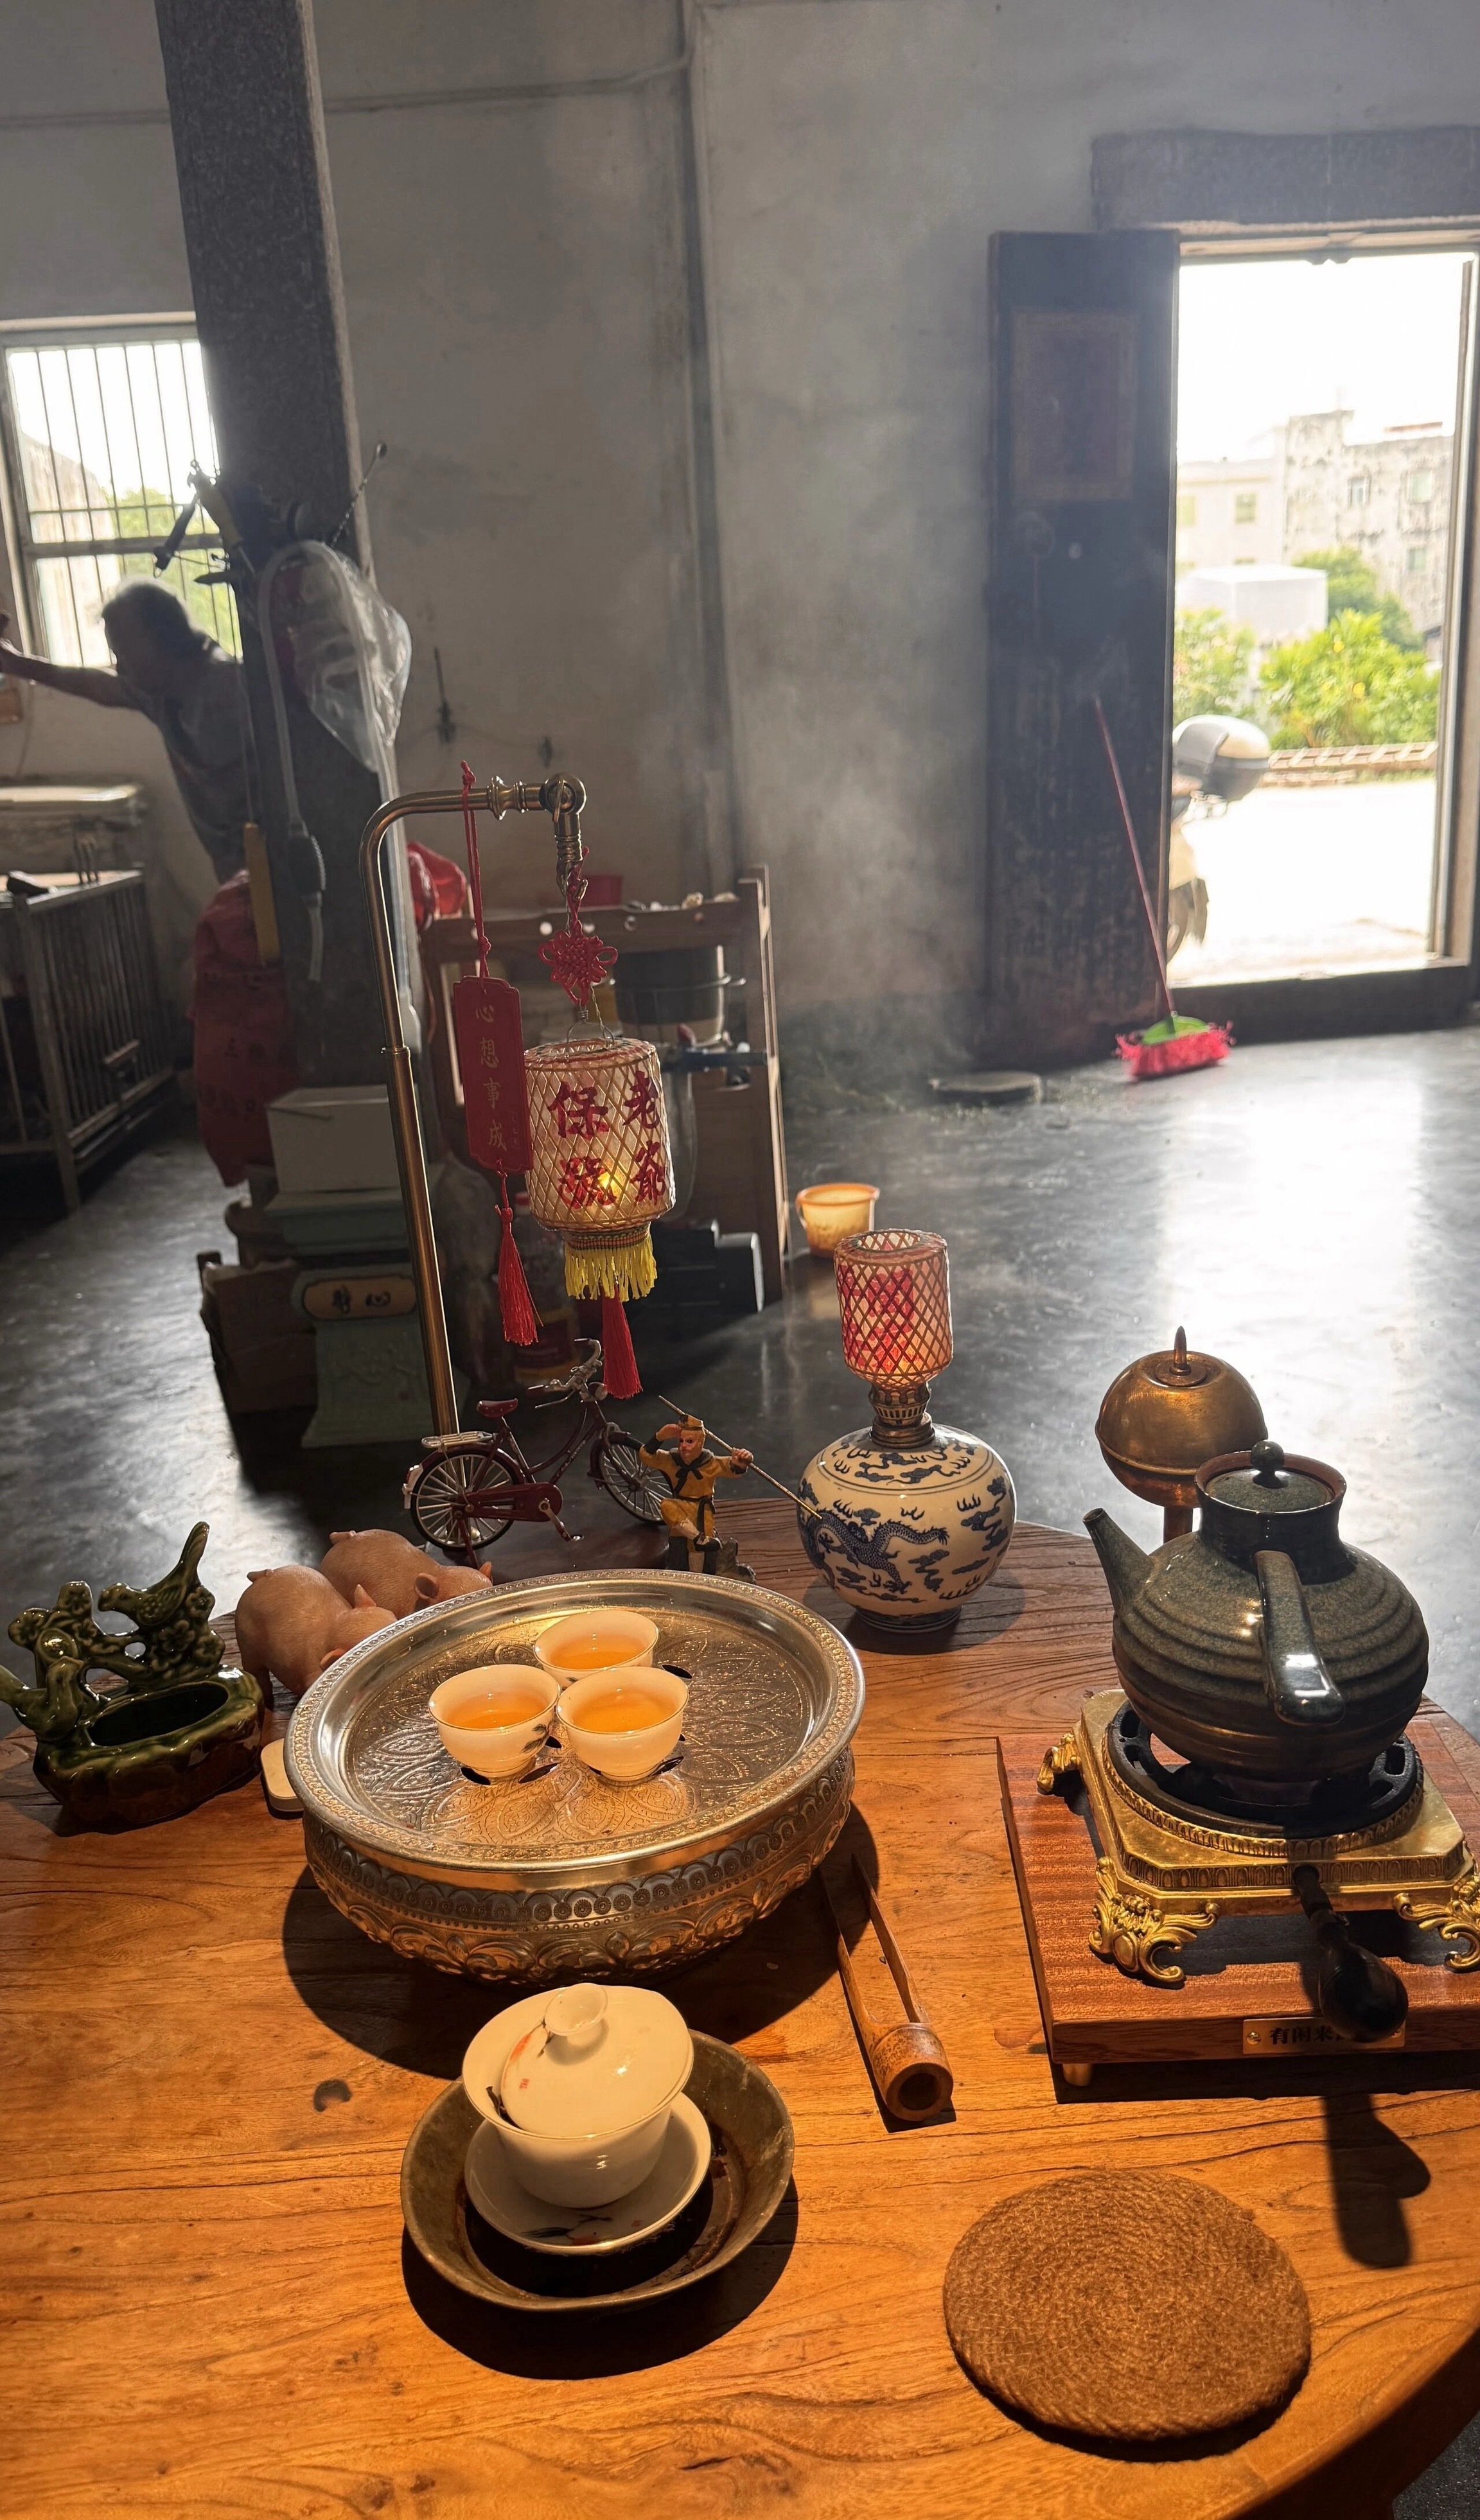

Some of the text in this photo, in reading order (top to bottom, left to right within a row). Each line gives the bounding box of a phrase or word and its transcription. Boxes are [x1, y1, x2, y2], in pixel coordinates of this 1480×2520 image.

[475, 1004, 507, 1151] 心想事成
[1270, 2026, 1349, 2045] 有闲来
